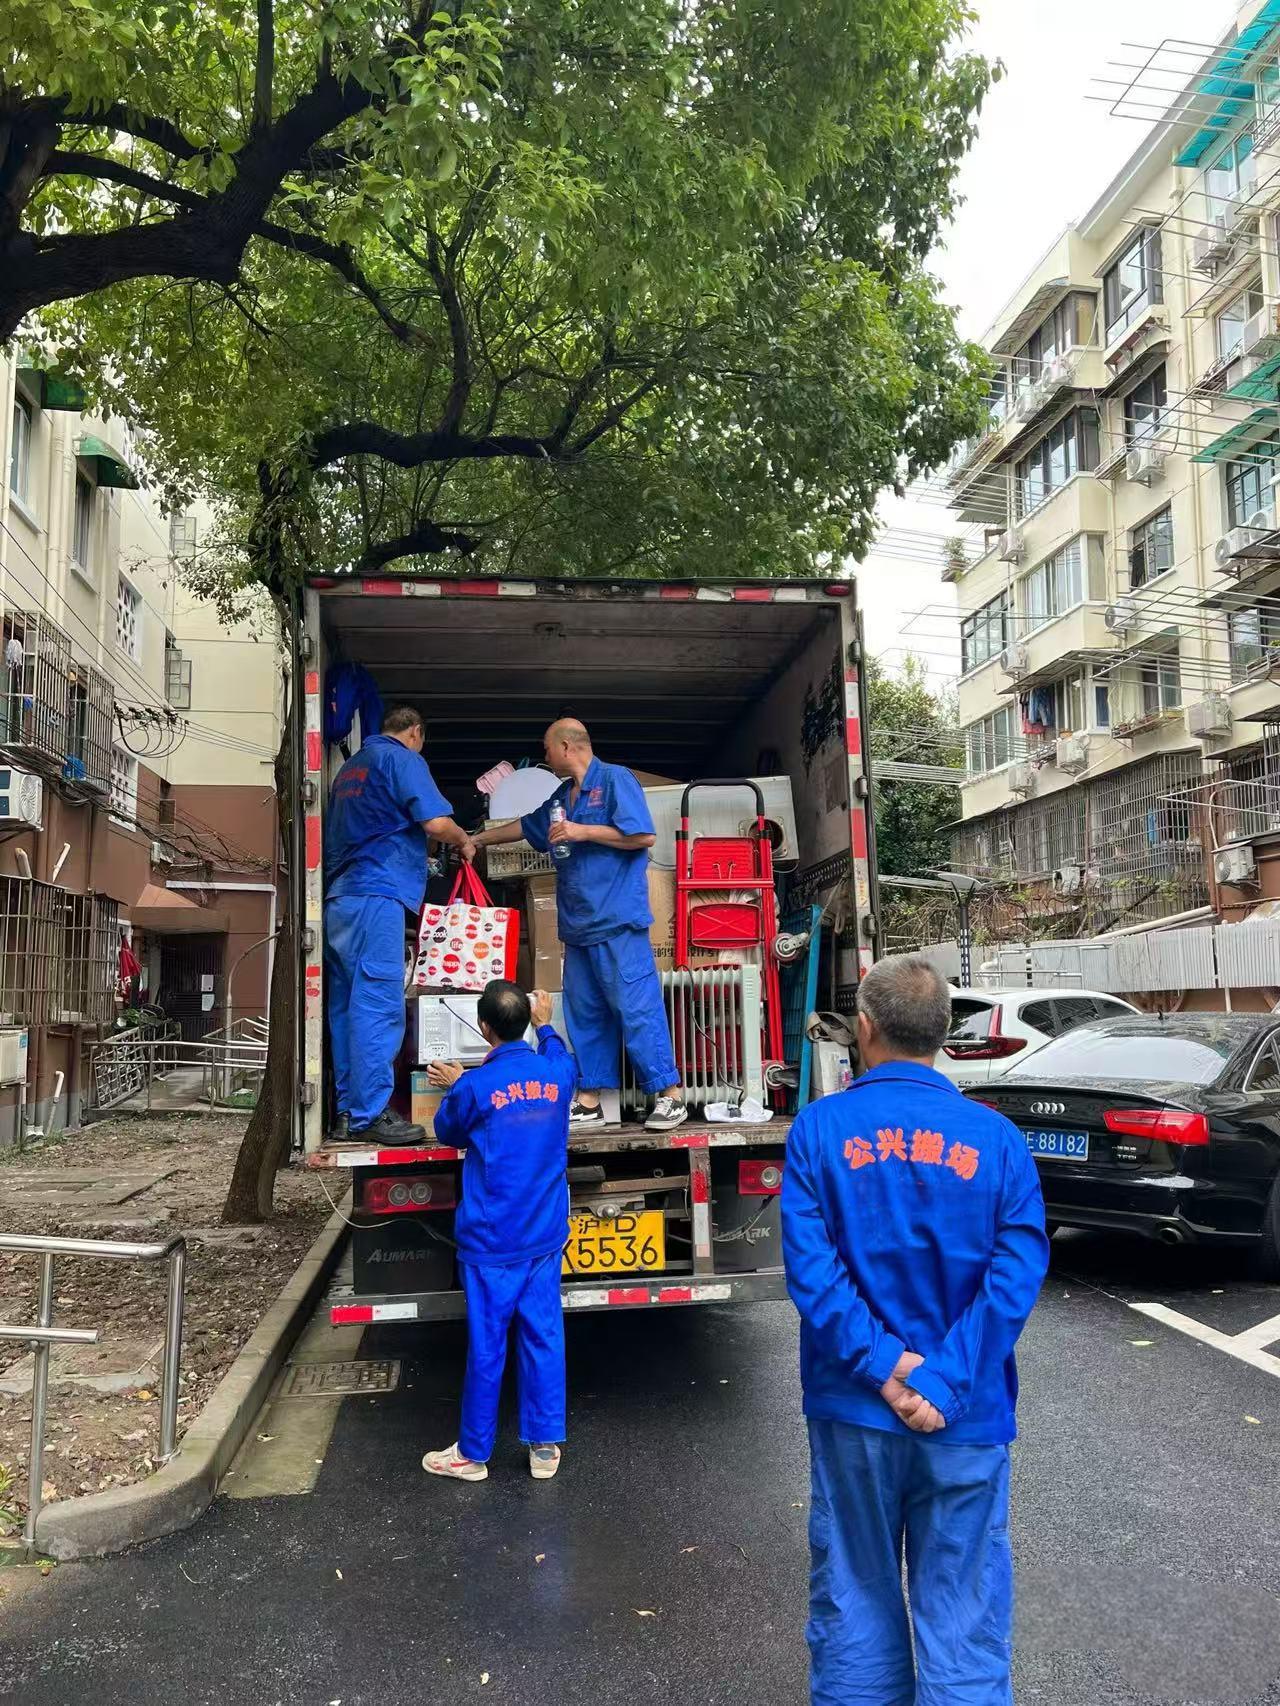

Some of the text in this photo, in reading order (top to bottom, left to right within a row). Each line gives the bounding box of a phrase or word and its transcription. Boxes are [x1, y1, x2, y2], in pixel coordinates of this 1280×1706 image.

[843, 1127, 979, 1180] 公兴搬场
[1021, 1130, 1086, 1154] E·88182
